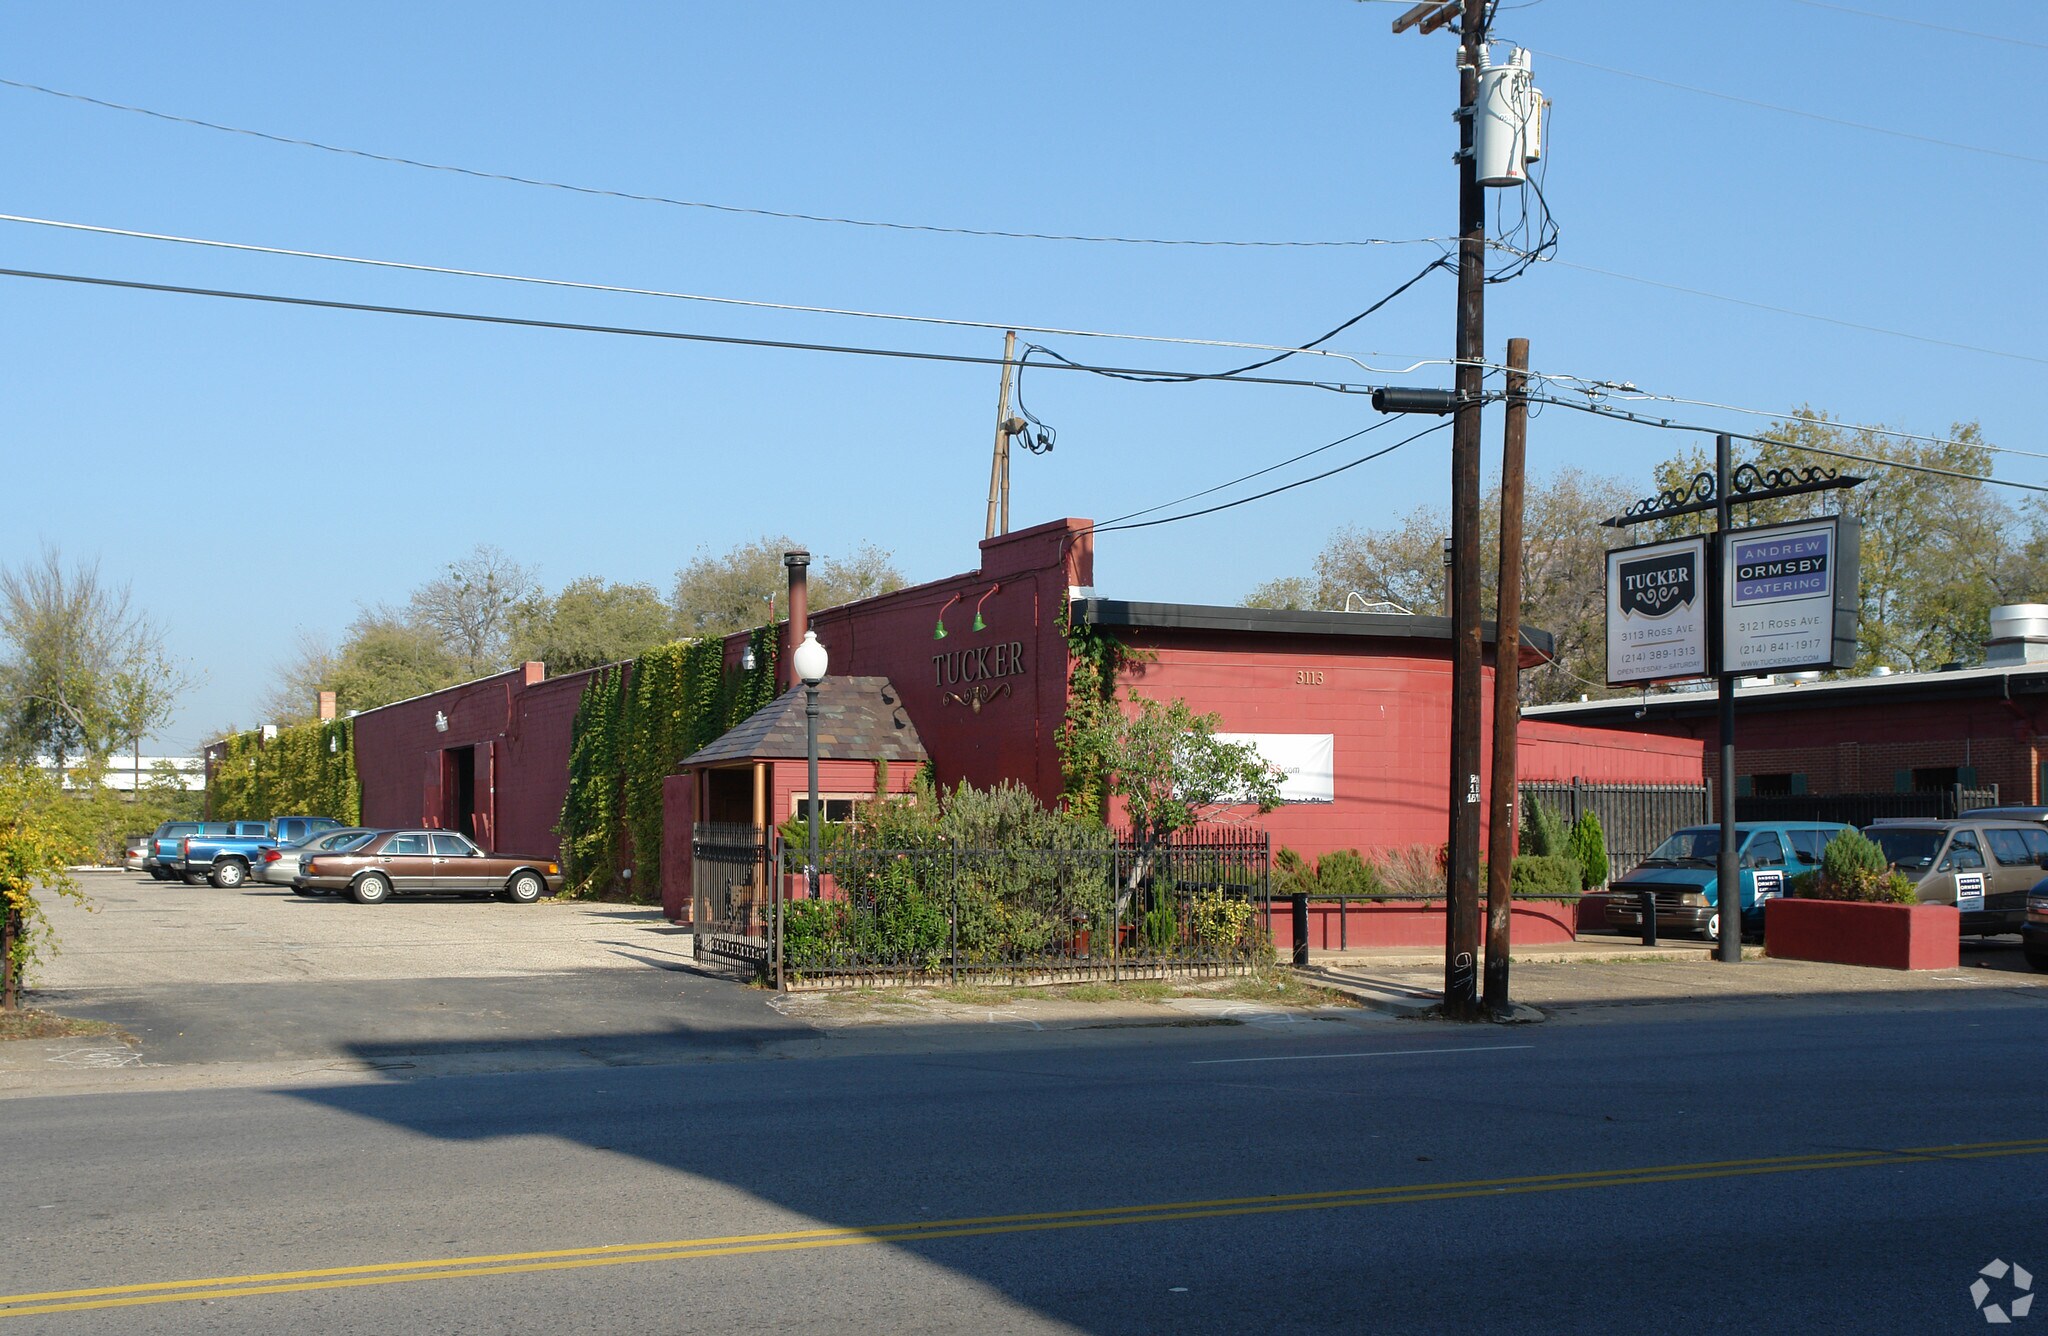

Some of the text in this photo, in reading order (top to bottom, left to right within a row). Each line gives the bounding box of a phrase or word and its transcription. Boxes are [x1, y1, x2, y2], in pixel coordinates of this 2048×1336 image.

[1745, 541, 1820, 559] ANDREW
[1740, 558, 1823, 579] ORMSBY
[1625, 567, 1689, 591] TUCKER
[1743, 578, 1821, 595] CATERING
[1739, 621, 1765, 632] 3121
[1621, 630, 1644, 642] 3113
[1621, 646, 1696, 664] (214) 389-1313
[1739, 639, 1821, 655] (214) 841-1917
[932, 641, 1025, 687] TUCKER
[1617, 667, 1635, 676] OPEN
[1635, 665, 1662, 674] TUESDAY
[1669, 661, 1700, 670] SATURDAY
[1296, 670, 1324, 685] 3113
